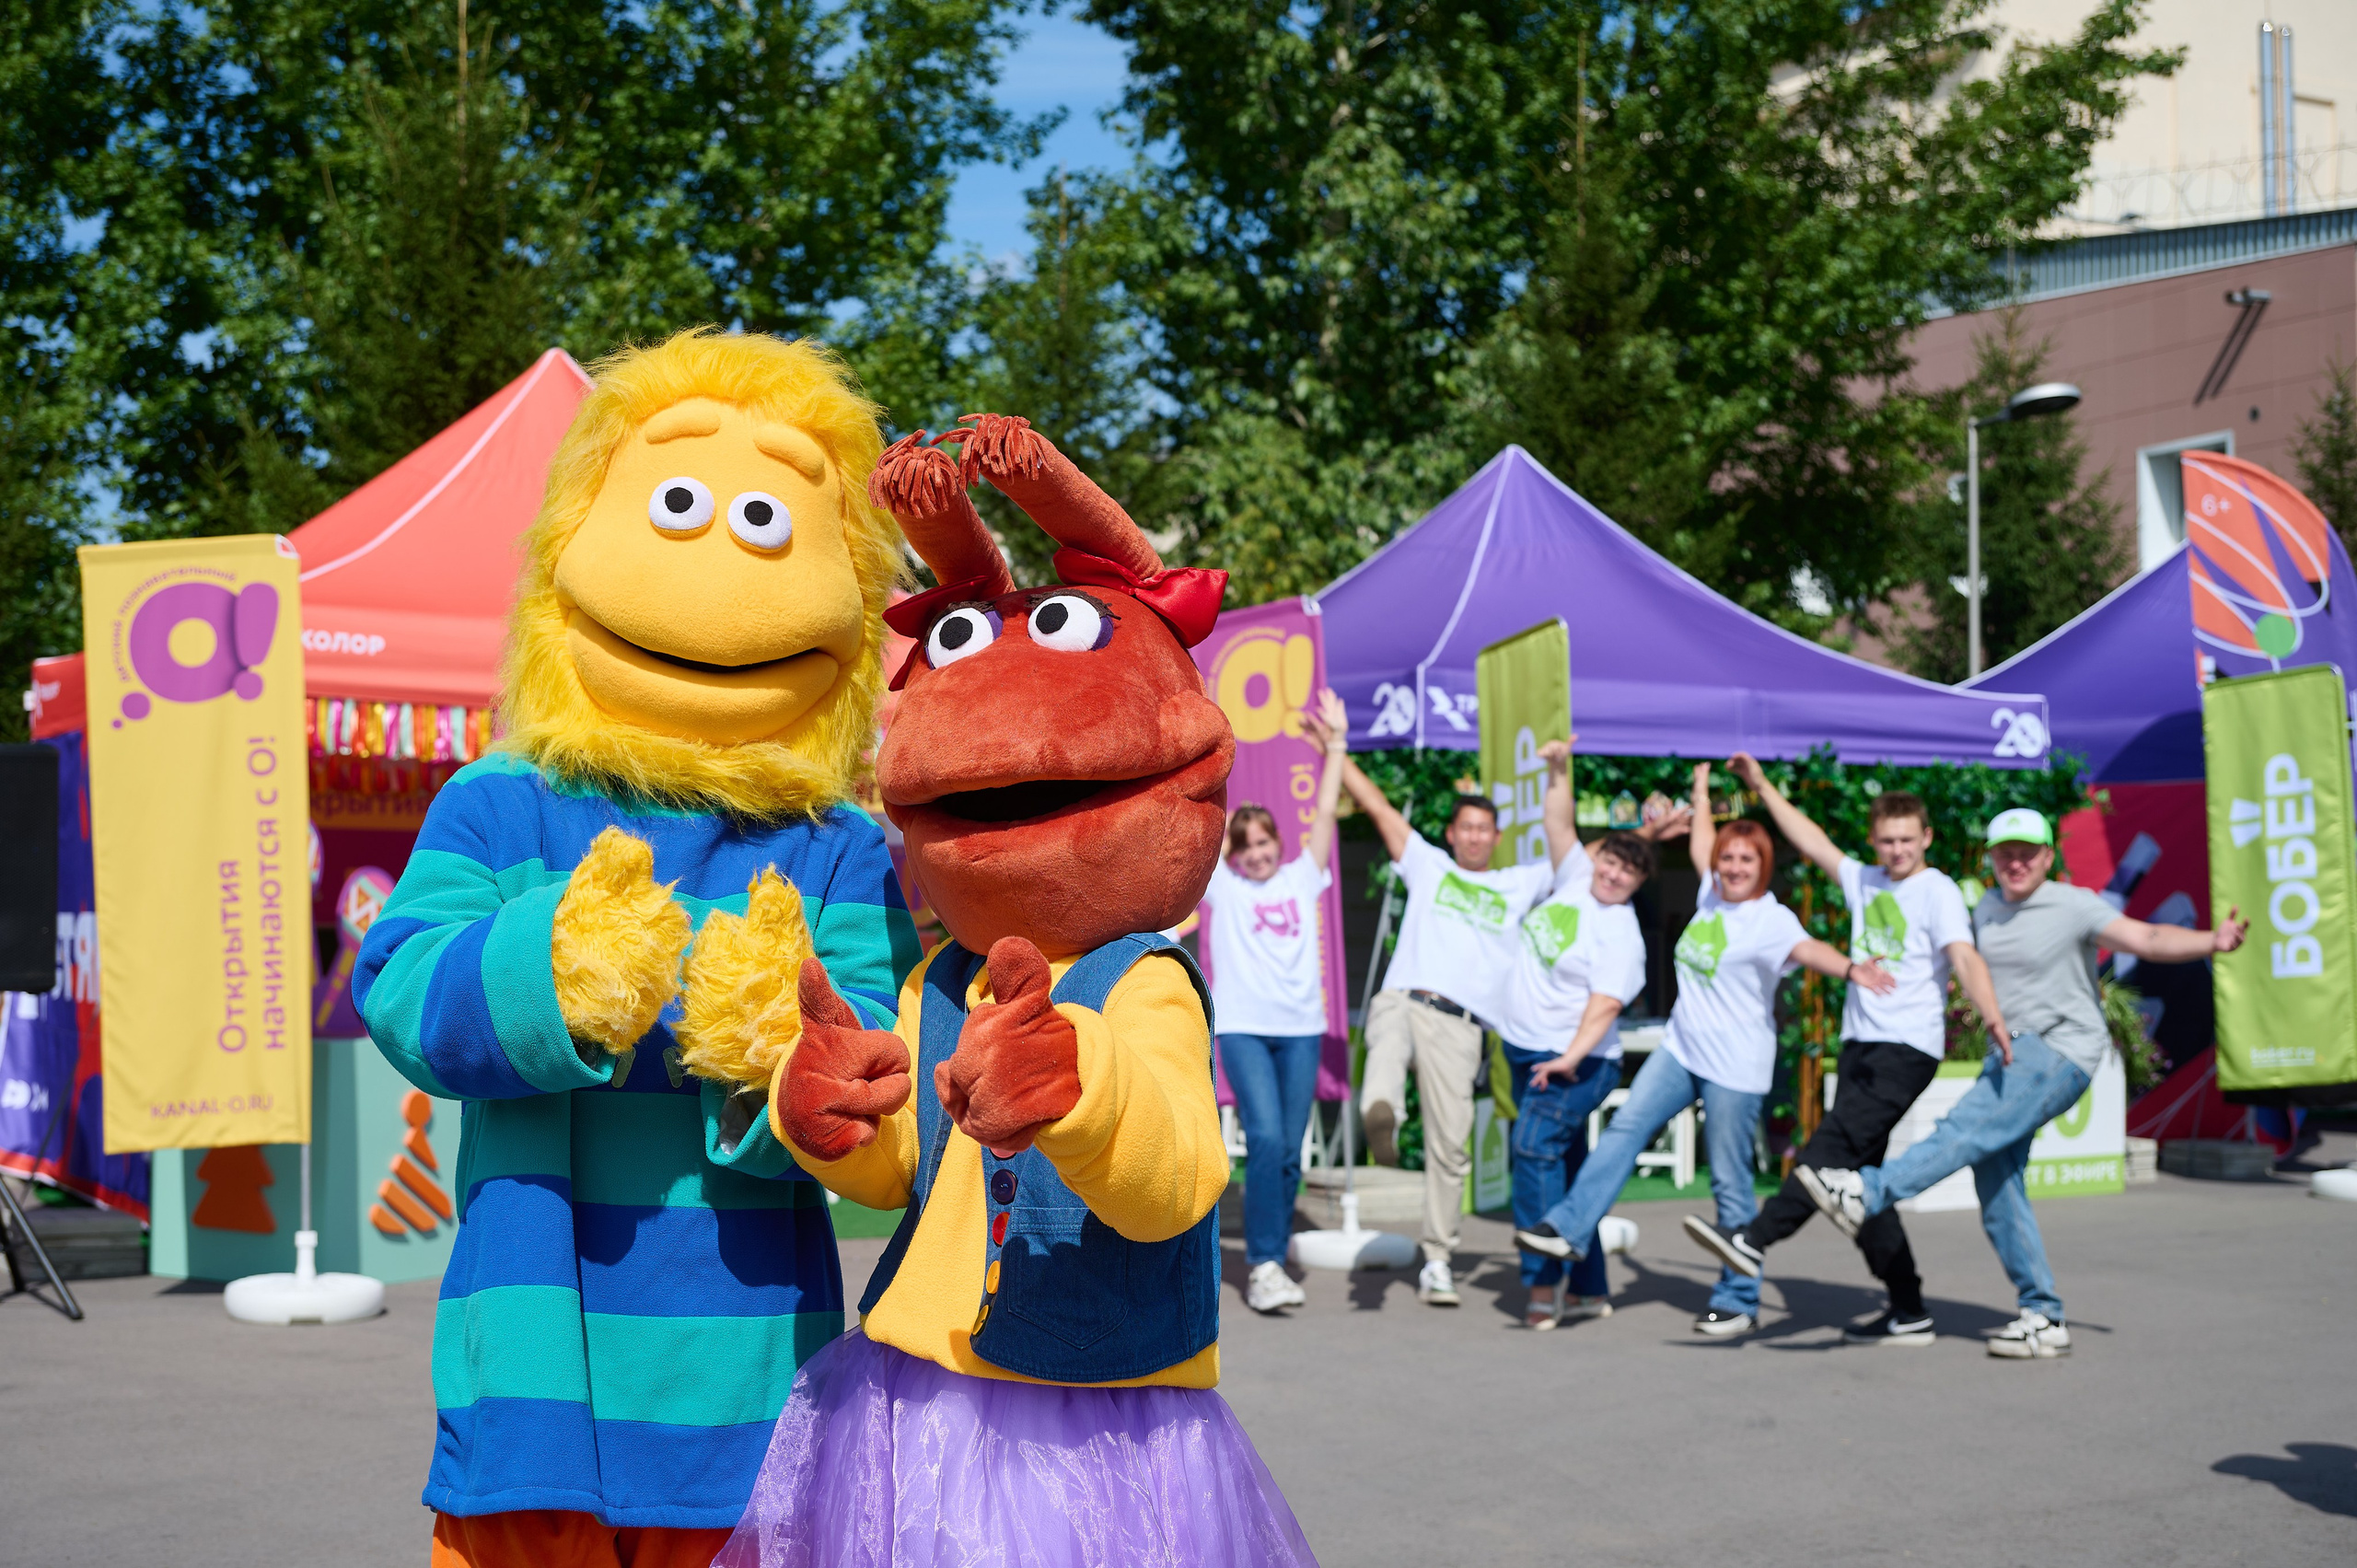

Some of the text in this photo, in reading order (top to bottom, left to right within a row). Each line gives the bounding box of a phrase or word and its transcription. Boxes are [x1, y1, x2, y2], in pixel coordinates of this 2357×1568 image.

[2201, 494, 2231, 517] 6+
[1991, 706, 2046, 759] 20
[217, 859, 249, 1052] Открытия
[247, 737, 286, 1051] начинаются с О!
